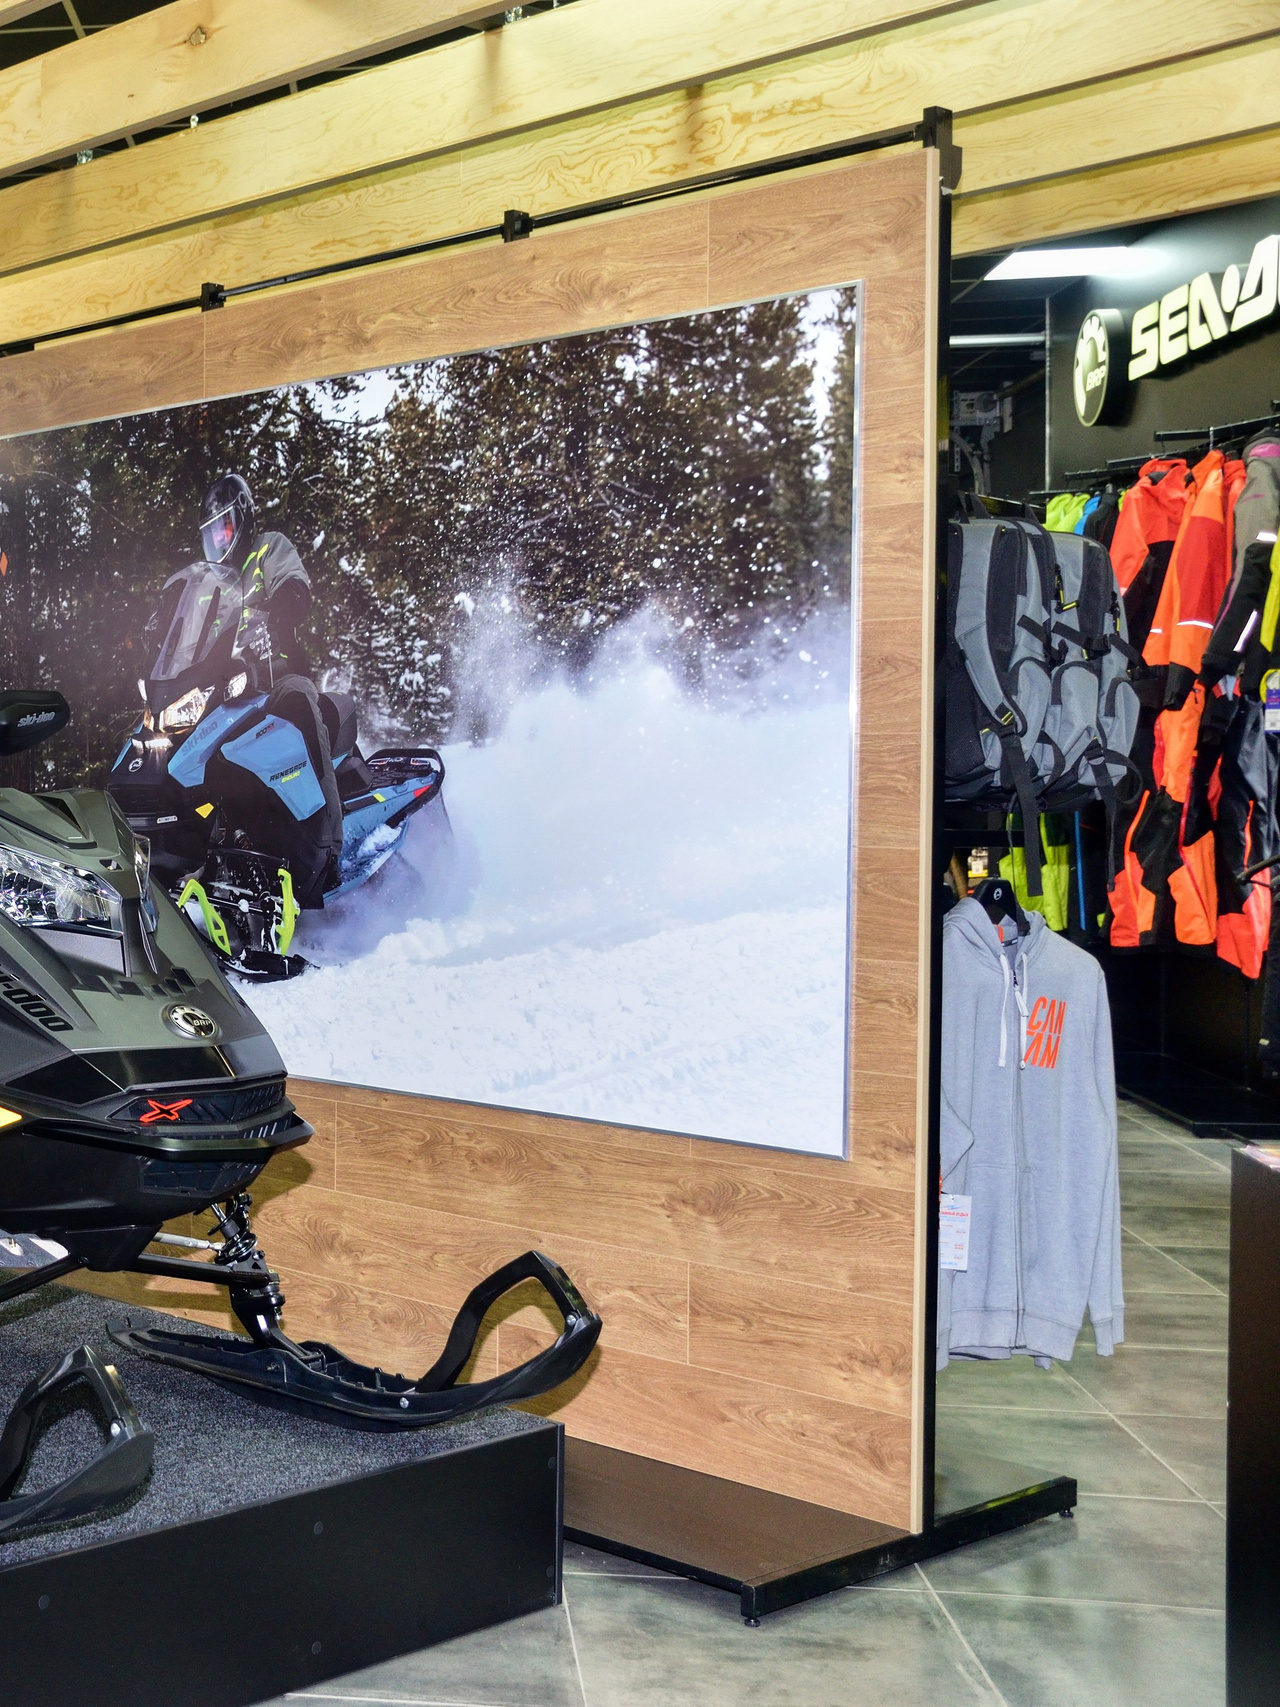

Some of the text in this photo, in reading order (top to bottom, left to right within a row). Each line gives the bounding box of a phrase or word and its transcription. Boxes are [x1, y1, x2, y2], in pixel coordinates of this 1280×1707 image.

[1128, 235, 1280, 381] SEA-D
[1086, 365, 1106, 392] BRP
[17, 711, 56, 727] ski-doo
